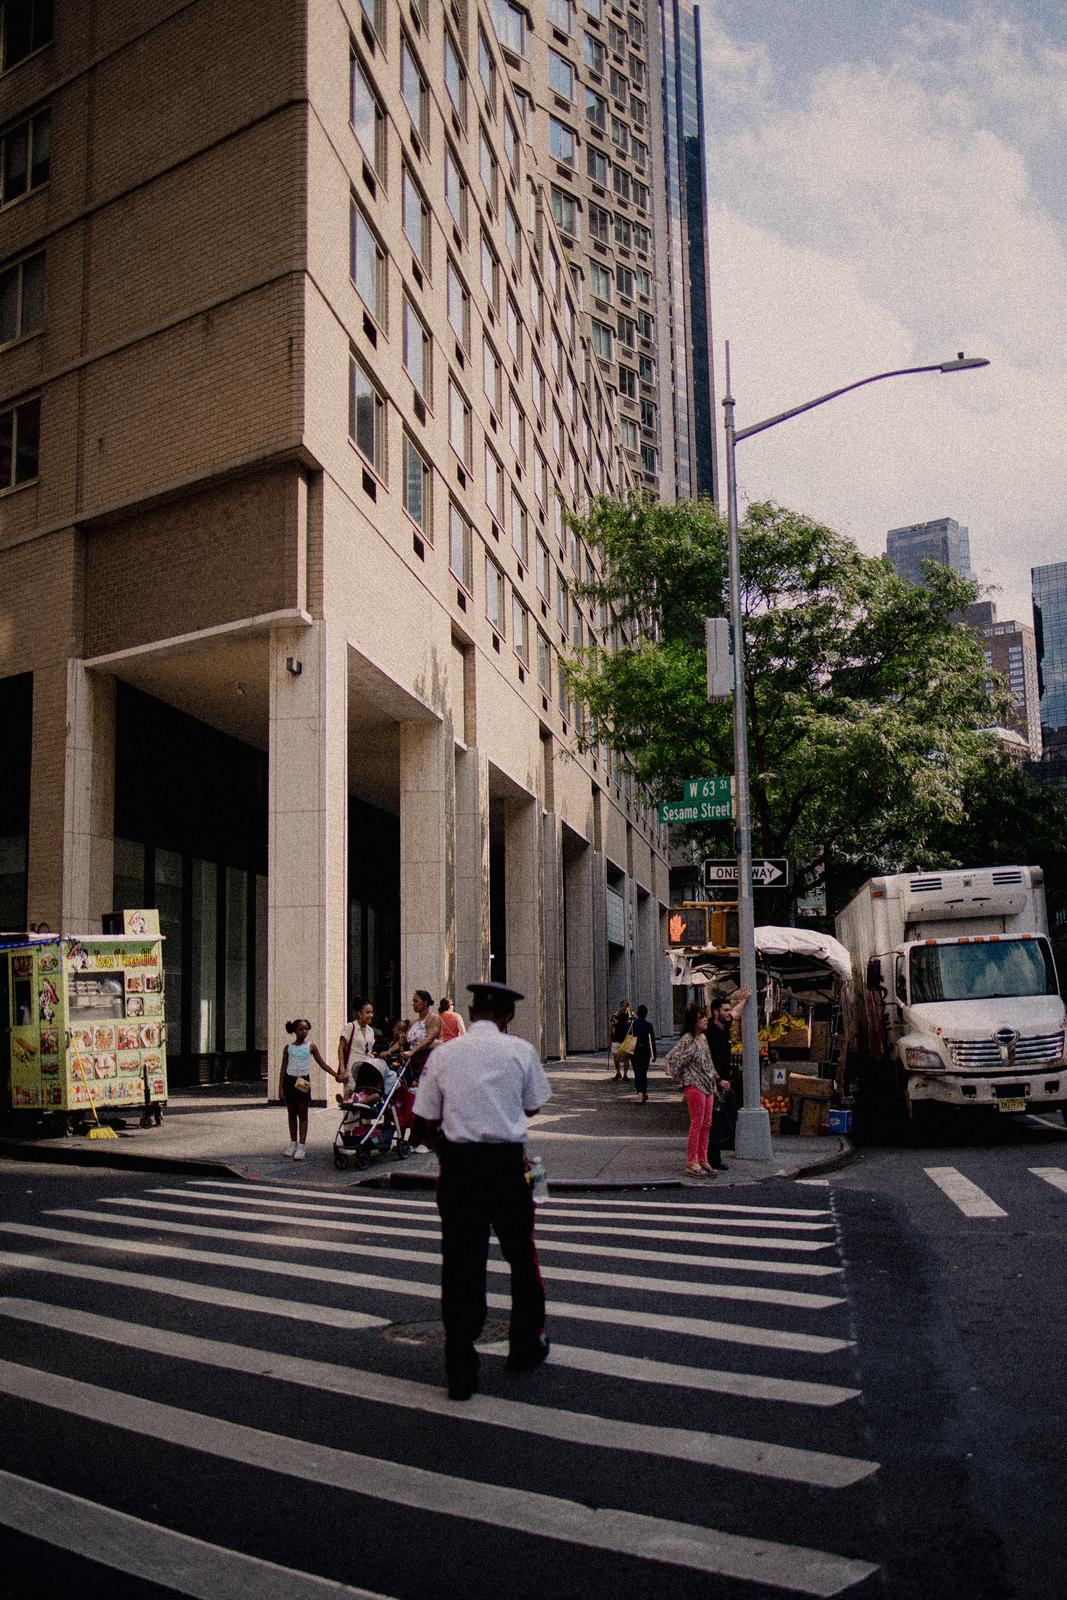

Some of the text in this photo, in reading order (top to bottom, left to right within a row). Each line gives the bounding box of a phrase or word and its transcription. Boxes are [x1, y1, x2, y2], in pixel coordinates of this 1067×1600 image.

[689, 779, 728, 798] W 63 St
[663, 801, 731, 821] Sesame Street
[716, 868, 775, 878] ONE WAY
